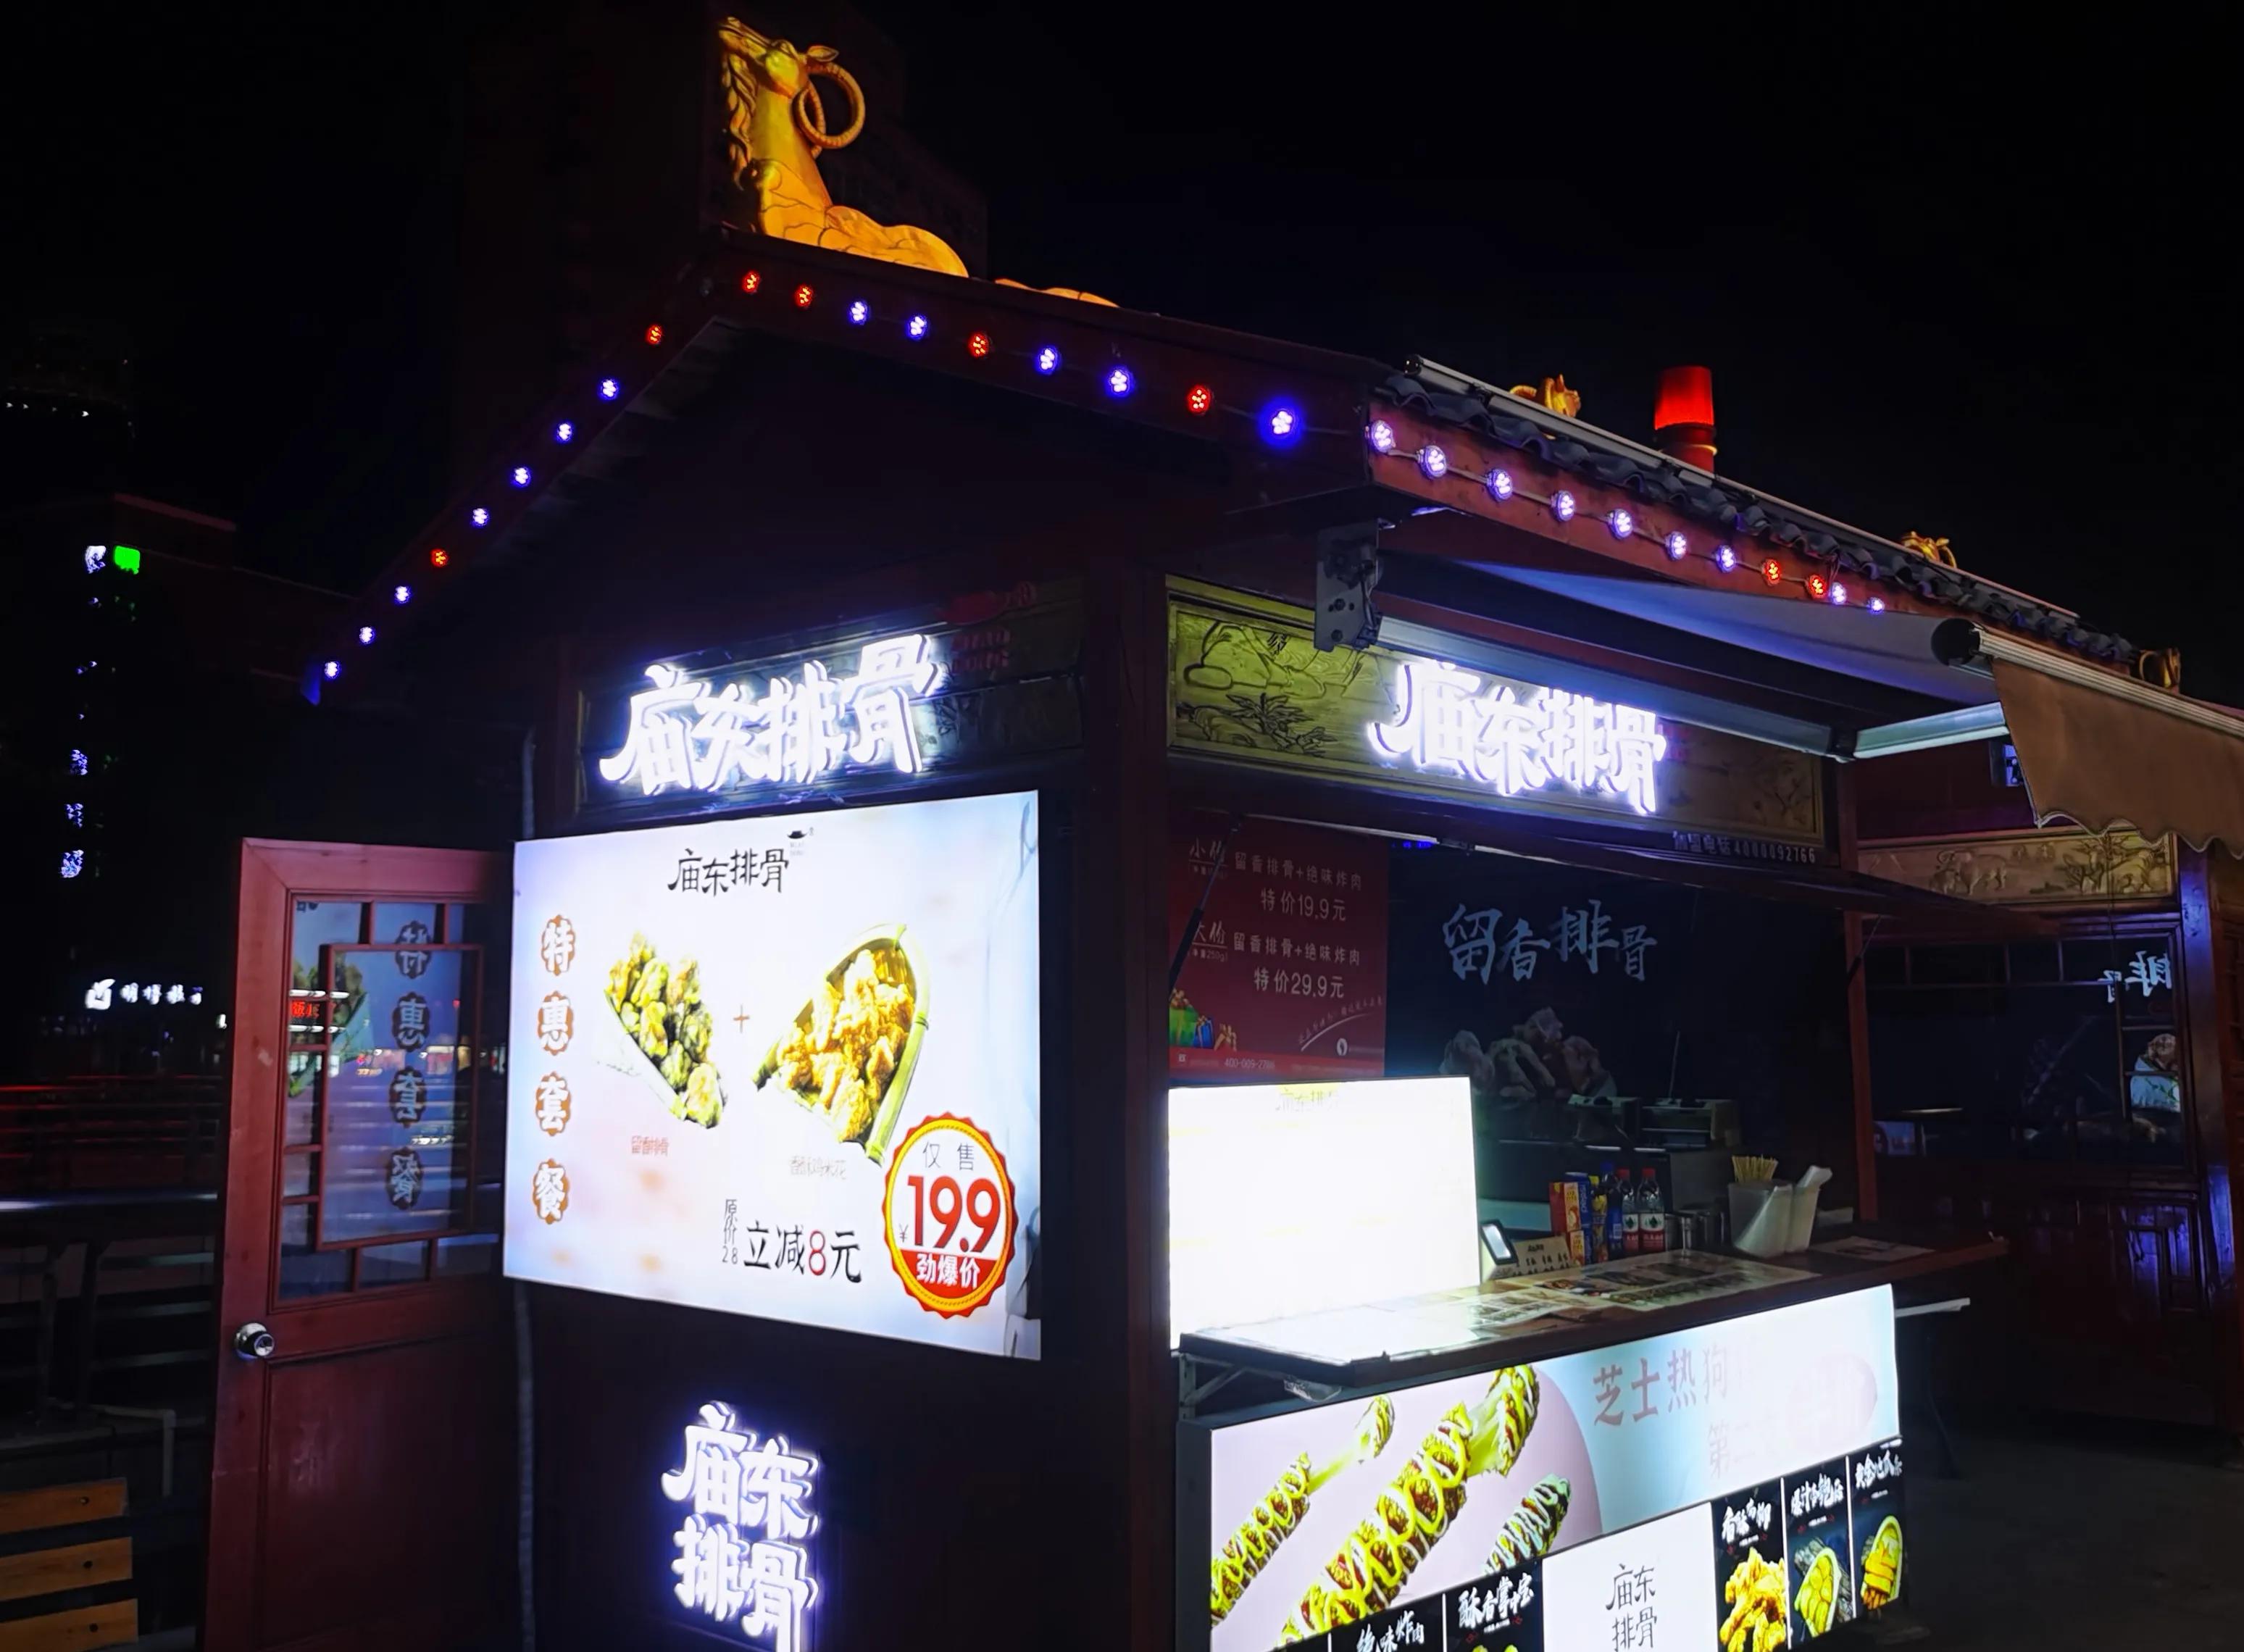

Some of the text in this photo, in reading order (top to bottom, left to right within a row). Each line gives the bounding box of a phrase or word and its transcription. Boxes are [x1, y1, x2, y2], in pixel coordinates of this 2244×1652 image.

[600, 633, 948, 795] 庙东排骨
[1369, 659, 1665, 814] 庙东排骨
[667, 848, 790, 897] 庙东排骨
[1260, 887, 1347, 922] 特价19.9元
[1442, 898, 1658, 985] 留香排骨
[1254, 967, 1346, 999] 特价29.9元
[922, 1140, 975, 1172] 仅售
[916, 1252, 980, 1289] 劲爆价
